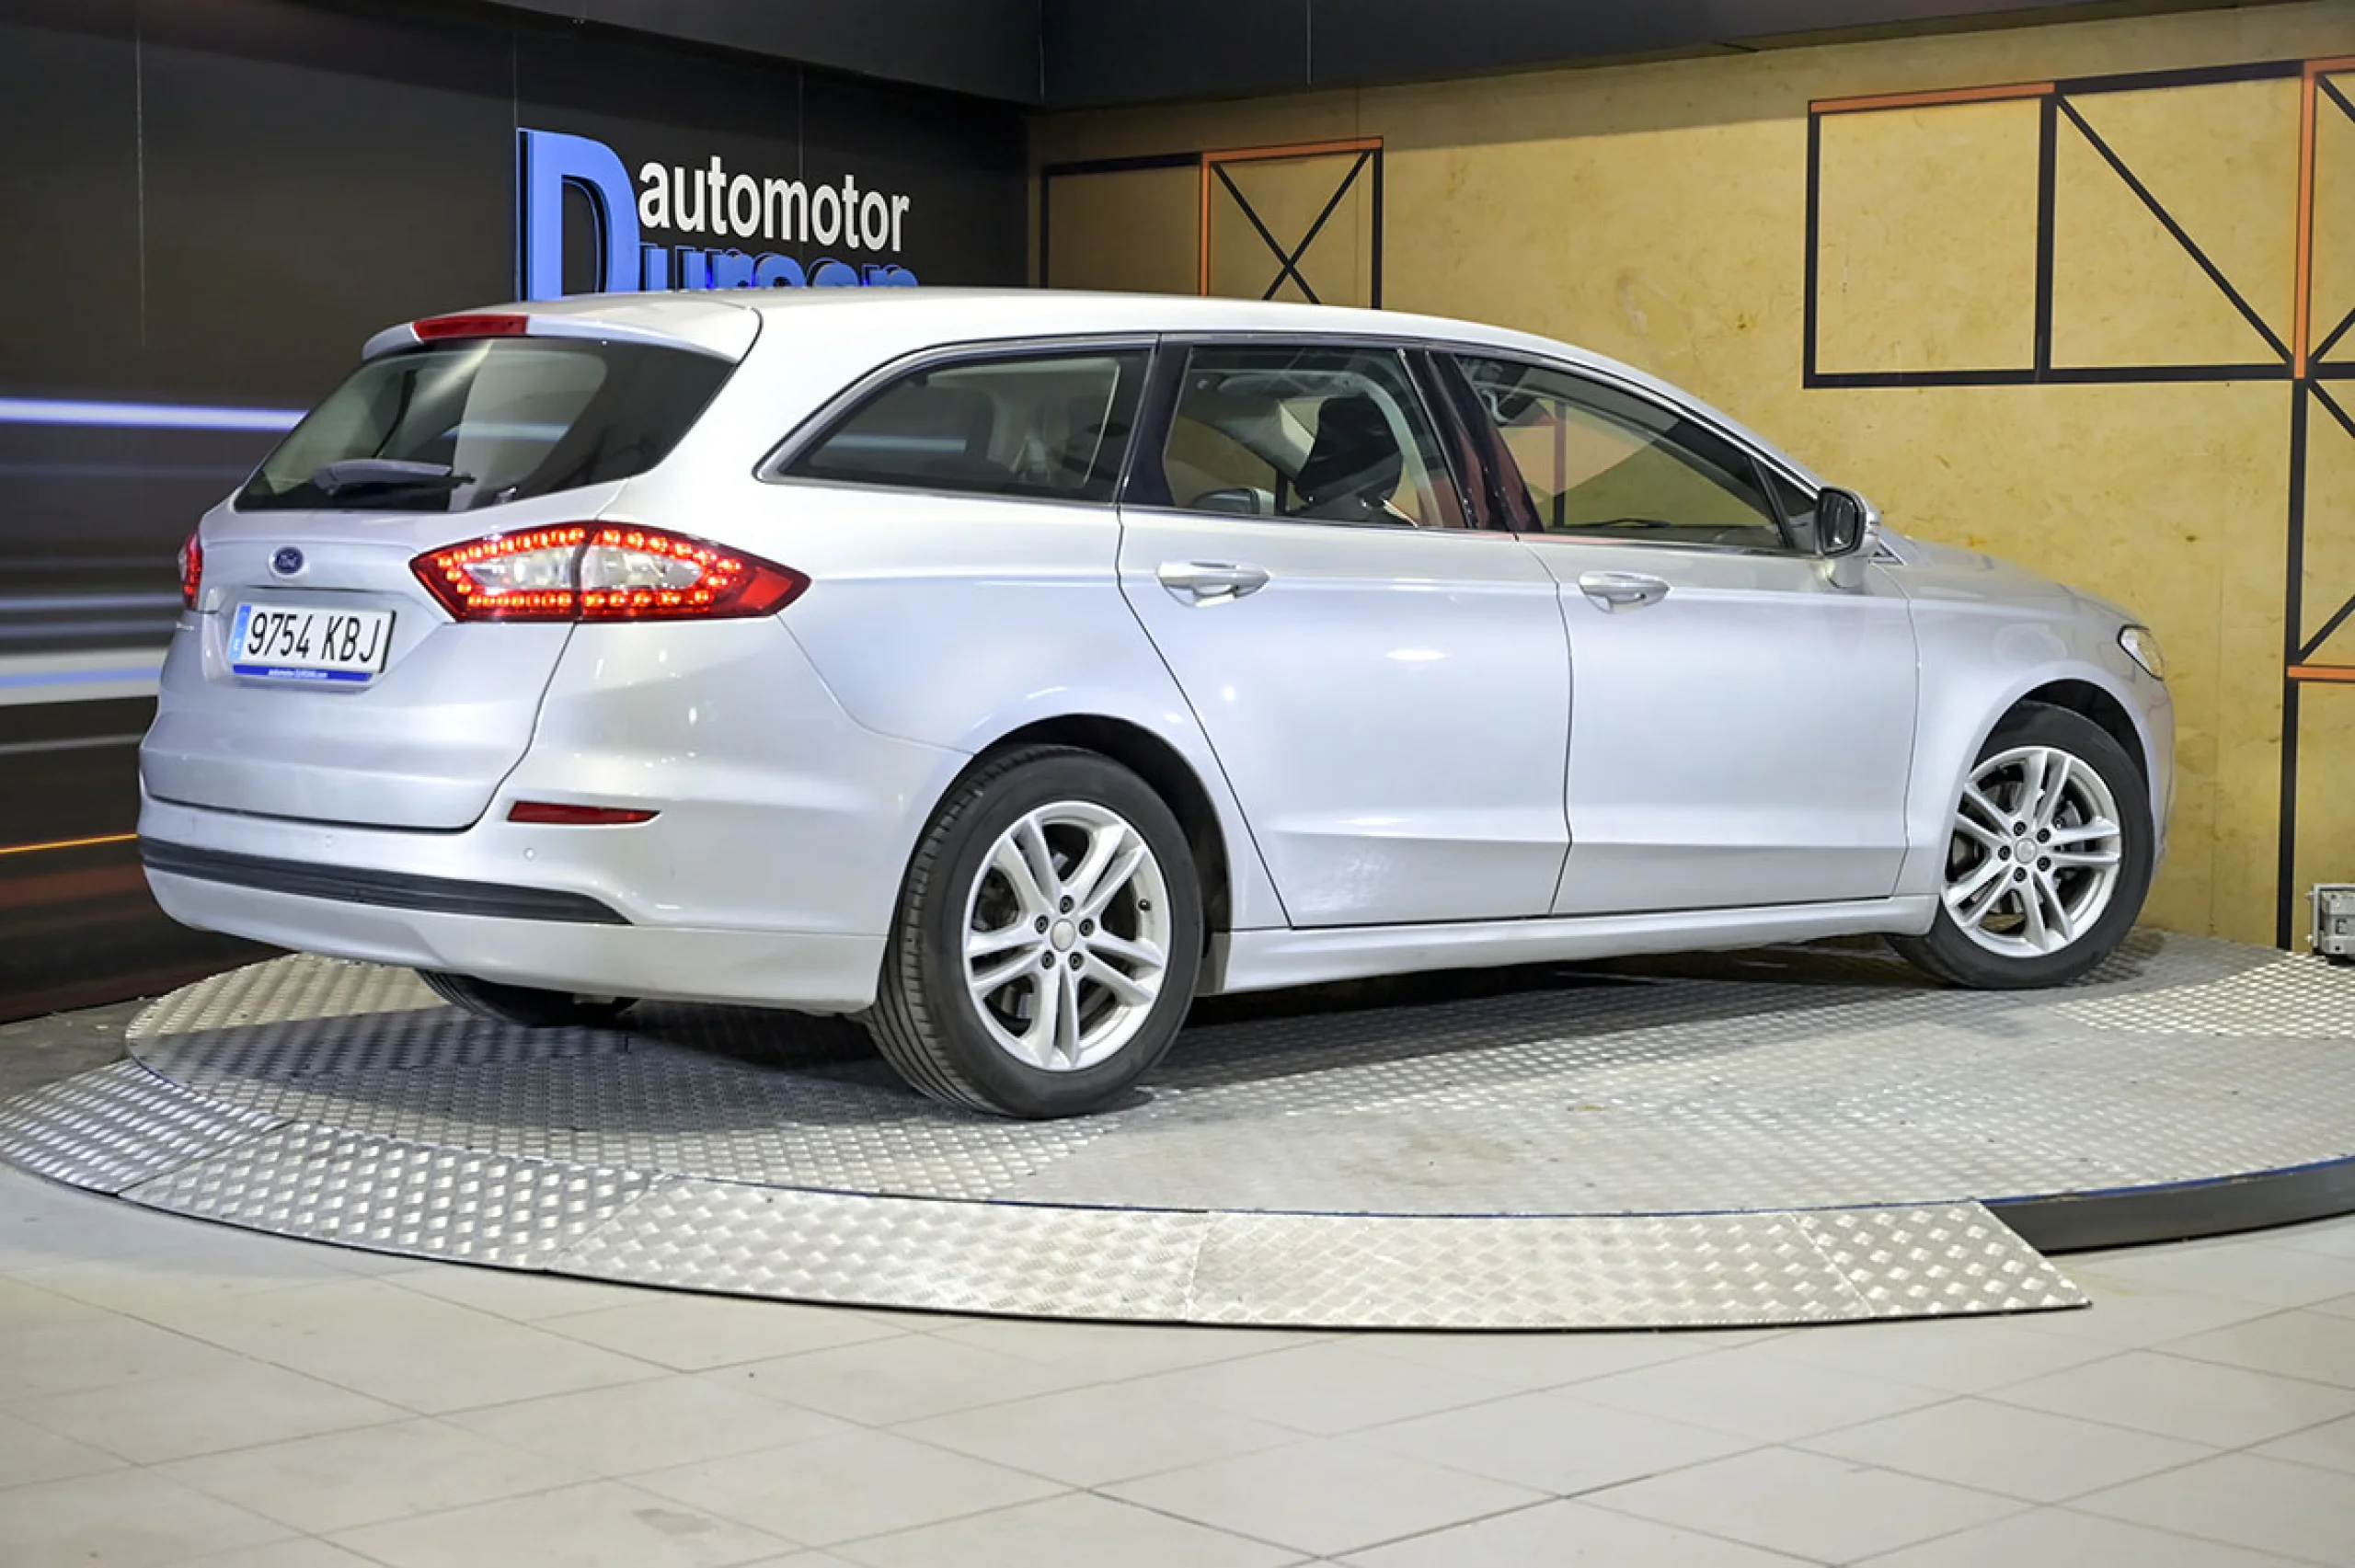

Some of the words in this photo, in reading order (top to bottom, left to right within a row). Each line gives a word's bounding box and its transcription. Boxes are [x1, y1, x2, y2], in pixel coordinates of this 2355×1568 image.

[639, 155, 910, 252] automotor
[248, 612, 314, 658] 9754
[321, 615, 381, 662] KBJ
